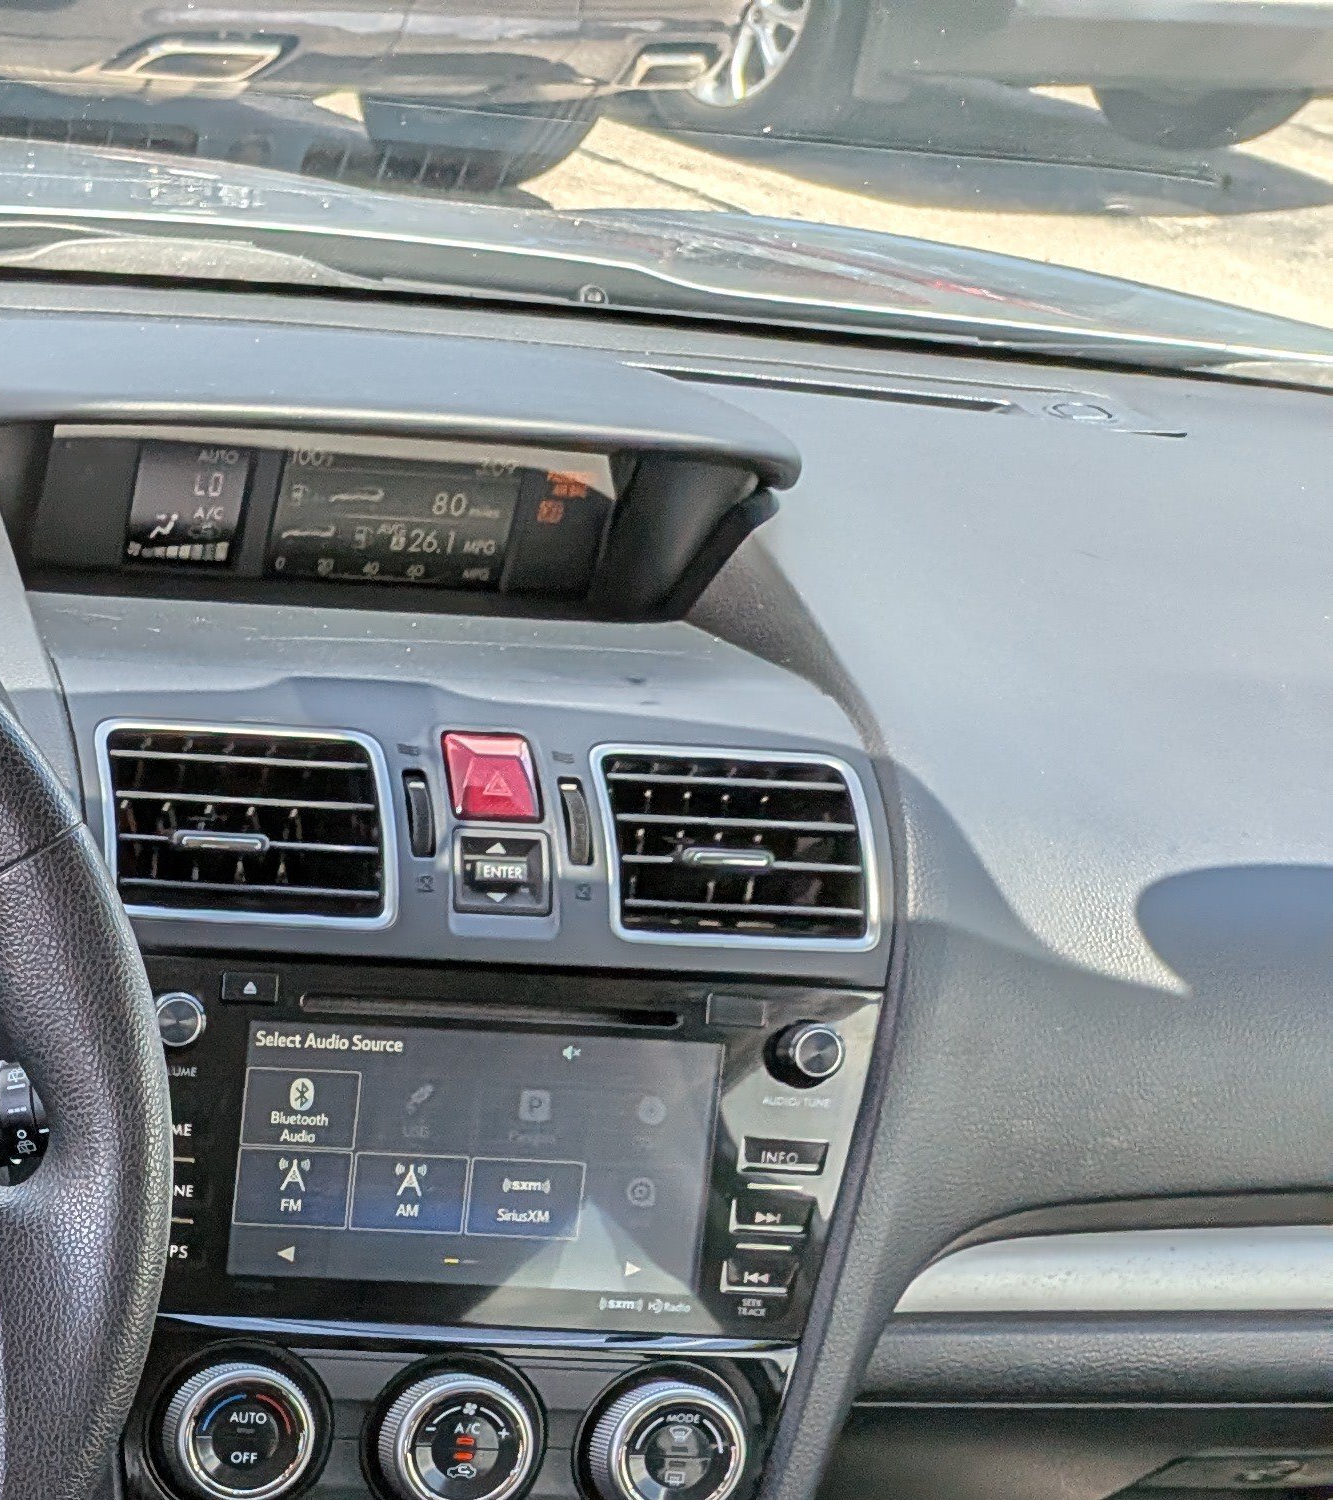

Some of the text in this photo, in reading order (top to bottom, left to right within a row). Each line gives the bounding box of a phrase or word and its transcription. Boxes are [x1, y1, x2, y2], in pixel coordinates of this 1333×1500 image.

[432, 492, 467, 516] 80
[193, 506, 225, 521] A/C
[482, 865, 524, 880] ENTER
[255, 1030, 404, 1053] Select Audio Source
[270, 1110, 329, 1127] Bluetooth
[172, 1124, 192, 1137] ME
[280, 1129, 316, 1144] Audio
[760, 1150, 799, 1165] INFO
[280, 1199, 302, 1212] FM
[395, 1204, 420, 1218] AM
[496, 1208, 551, 1224] SiriusXM
[169, 1245, 189, 1260] PS
[229, 1410, 268, 1426] AUTO
[666, 1411, 701, 1426] MODE
[453, 1421, 481, 1437] A/C
[229, 1449, 259, 1466] OFF
